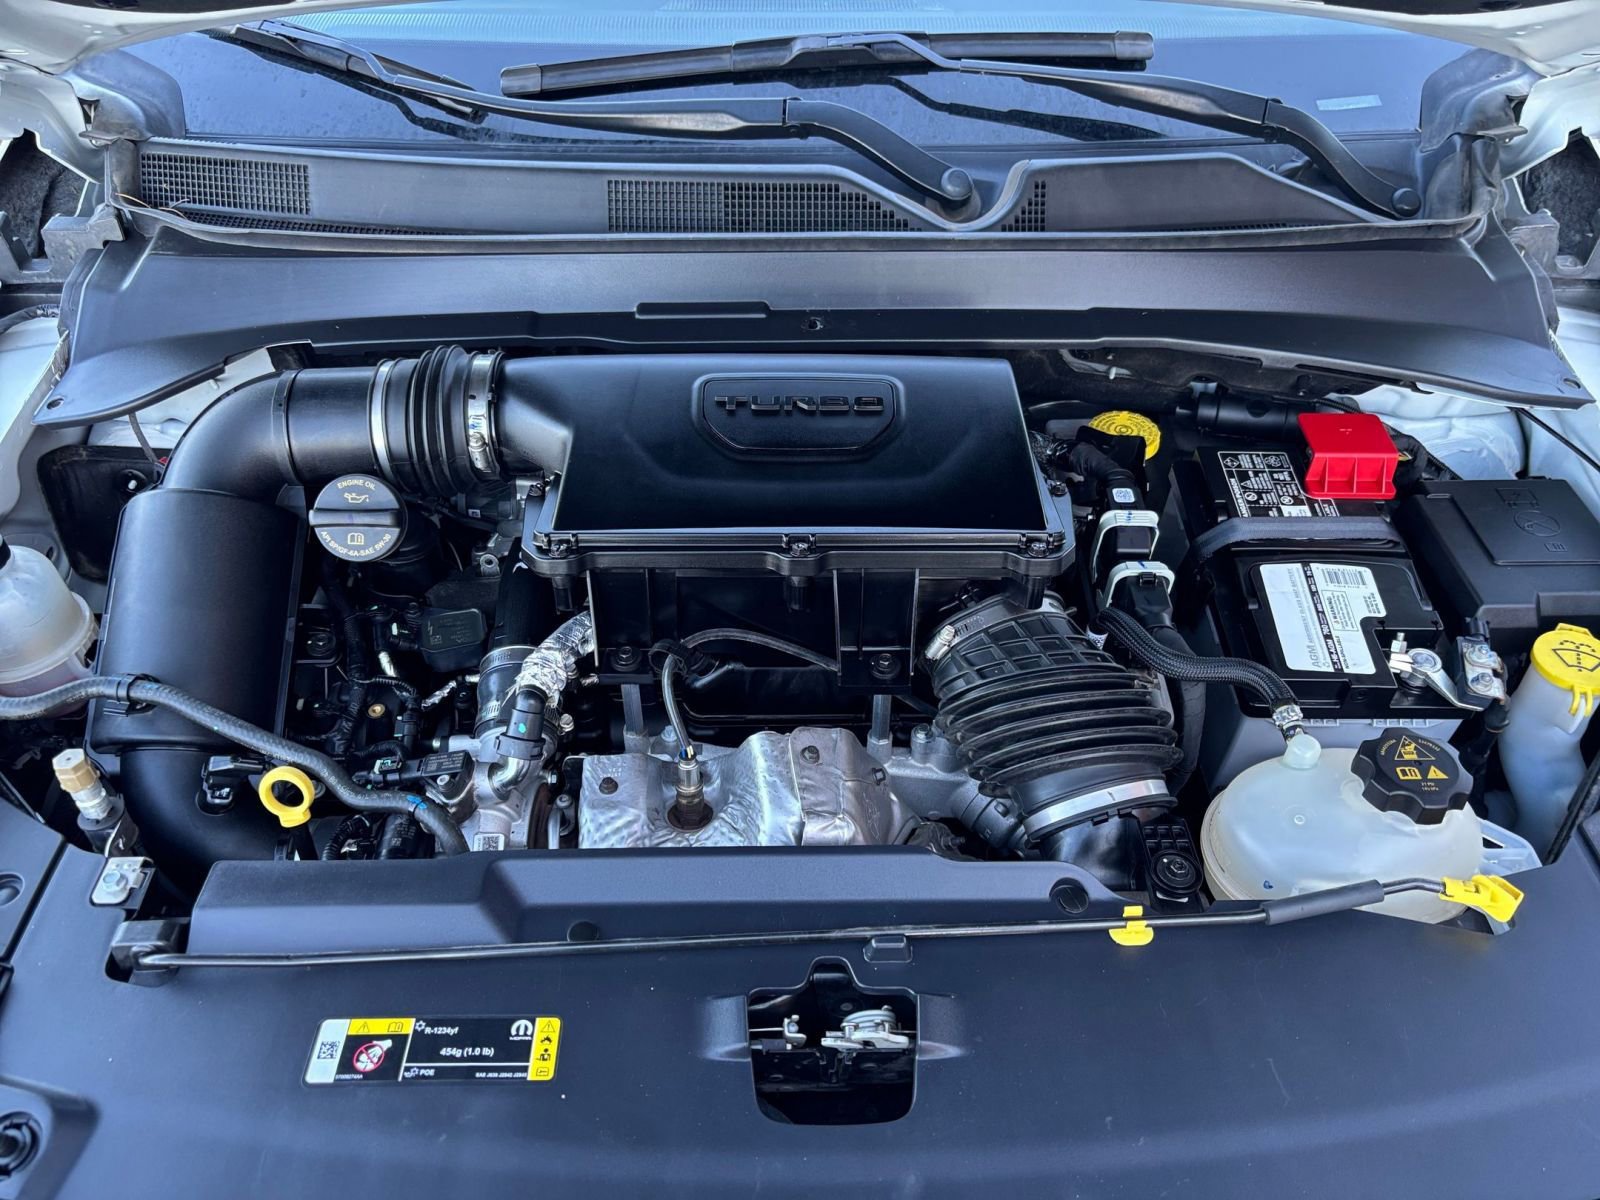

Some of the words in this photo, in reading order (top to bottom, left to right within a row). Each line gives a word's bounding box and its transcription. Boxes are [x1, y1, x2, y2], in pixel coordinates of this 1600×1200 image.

[714, 395, 885, 412] TURBO
[337, 479, 363, 489] ENGINE
[364, 481, 376, 490] OIL
[320, 531, 331, 543] API
[1306, 643, 1322, 668] AGM
[424, 1026, 459, 1036] R-1234yf
[440, 1047, 463, 1058] 454g
[463, 1047, 481, 1058] (1.0
[482, 1047, 494, 1058] lb)
